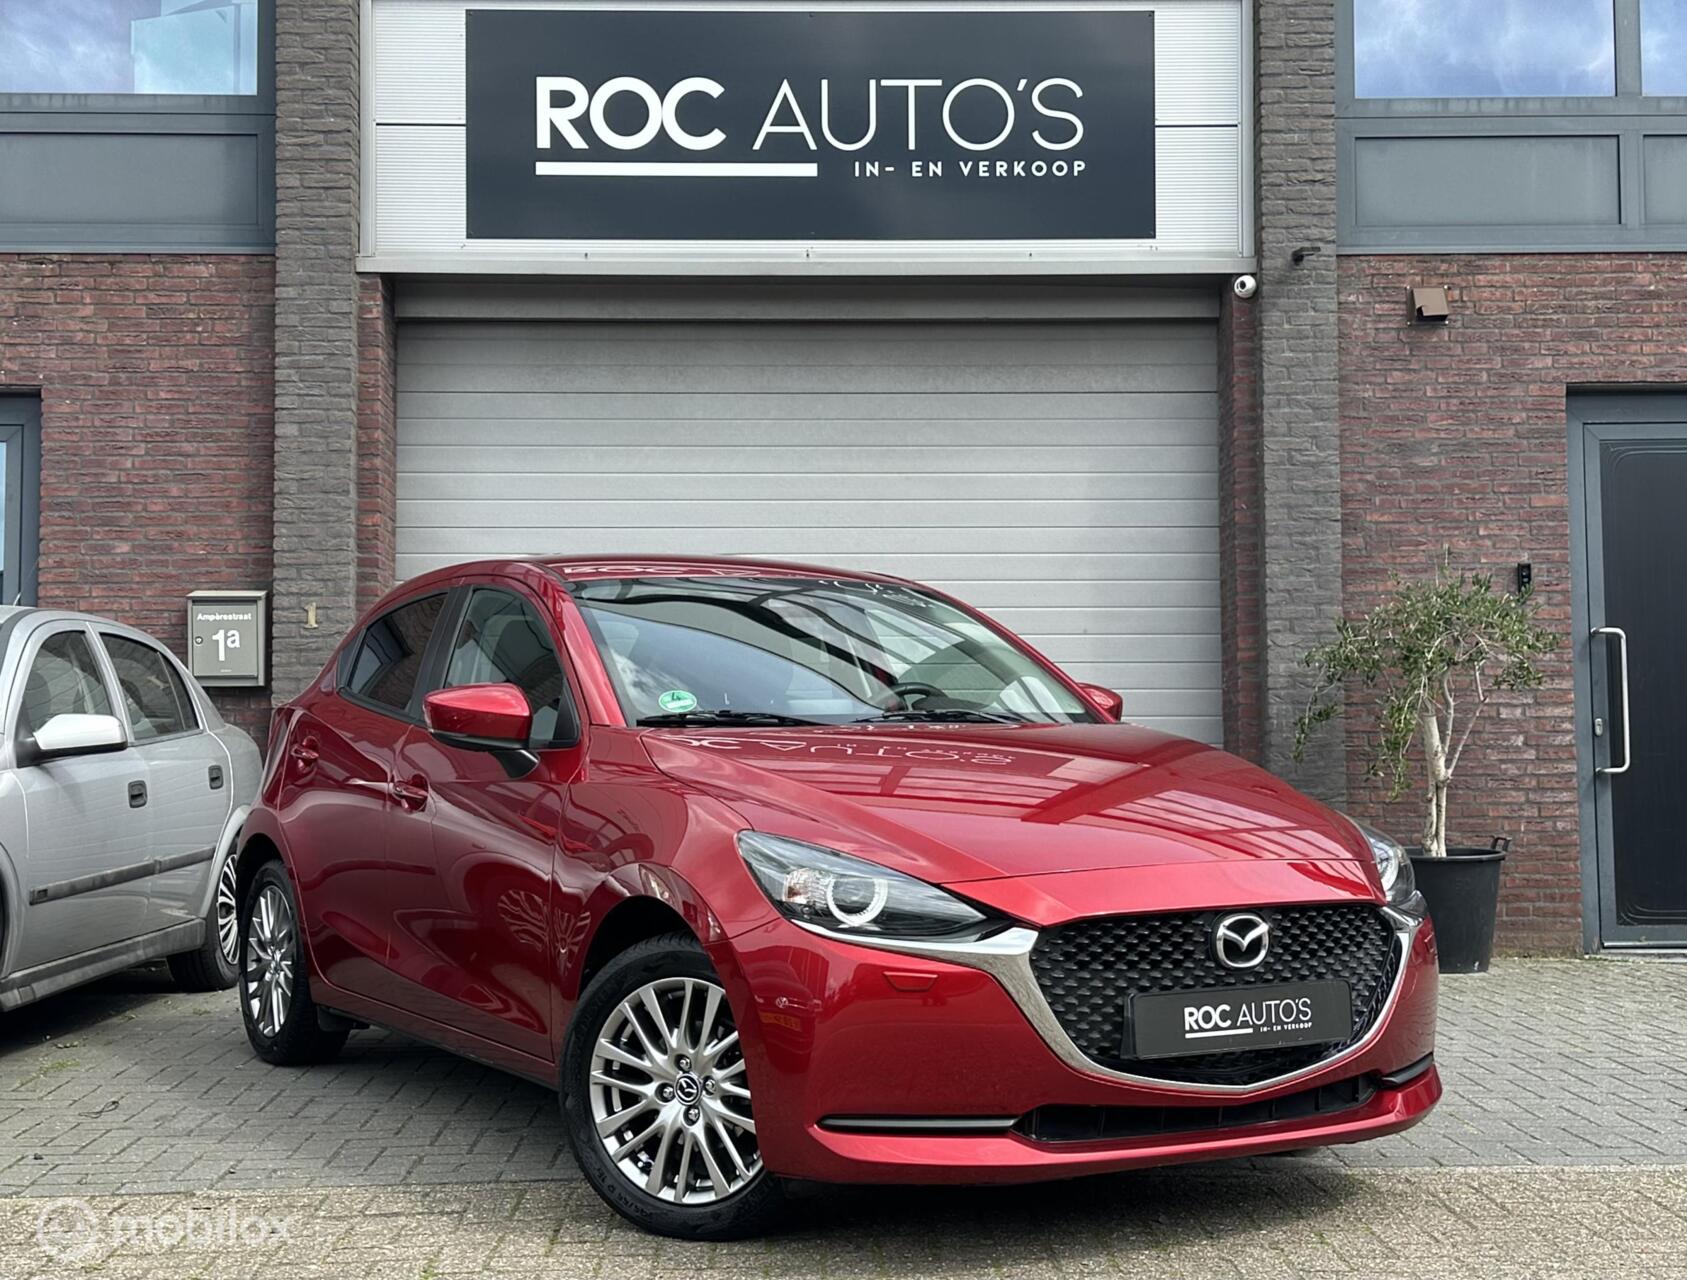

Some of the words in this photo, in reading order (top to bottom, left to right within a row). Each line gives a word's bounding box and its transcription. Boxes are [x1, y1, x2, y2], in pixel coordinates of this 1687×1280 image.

[535, 76, 727, 150] ROC
[752, 77, 1084, 151] AUTO'S
[854, 161, 895, 177] IN-
[912, 161, 943, 177] EN
[959, 161, 1088, 177] VERKOOP
[197, 612, 252, 622] Ampèrestraat
[304, 602, 319, 629] 1
[212, 629, 241, 661] 1a
[1184, 1004, 1232, 1031] ROC
[1237, 998, 1312, 1026] AUTO'S
[1273, 1024, 1282, 1032] EN
[1284, 1021, 1313, 1030] VERKOOP
